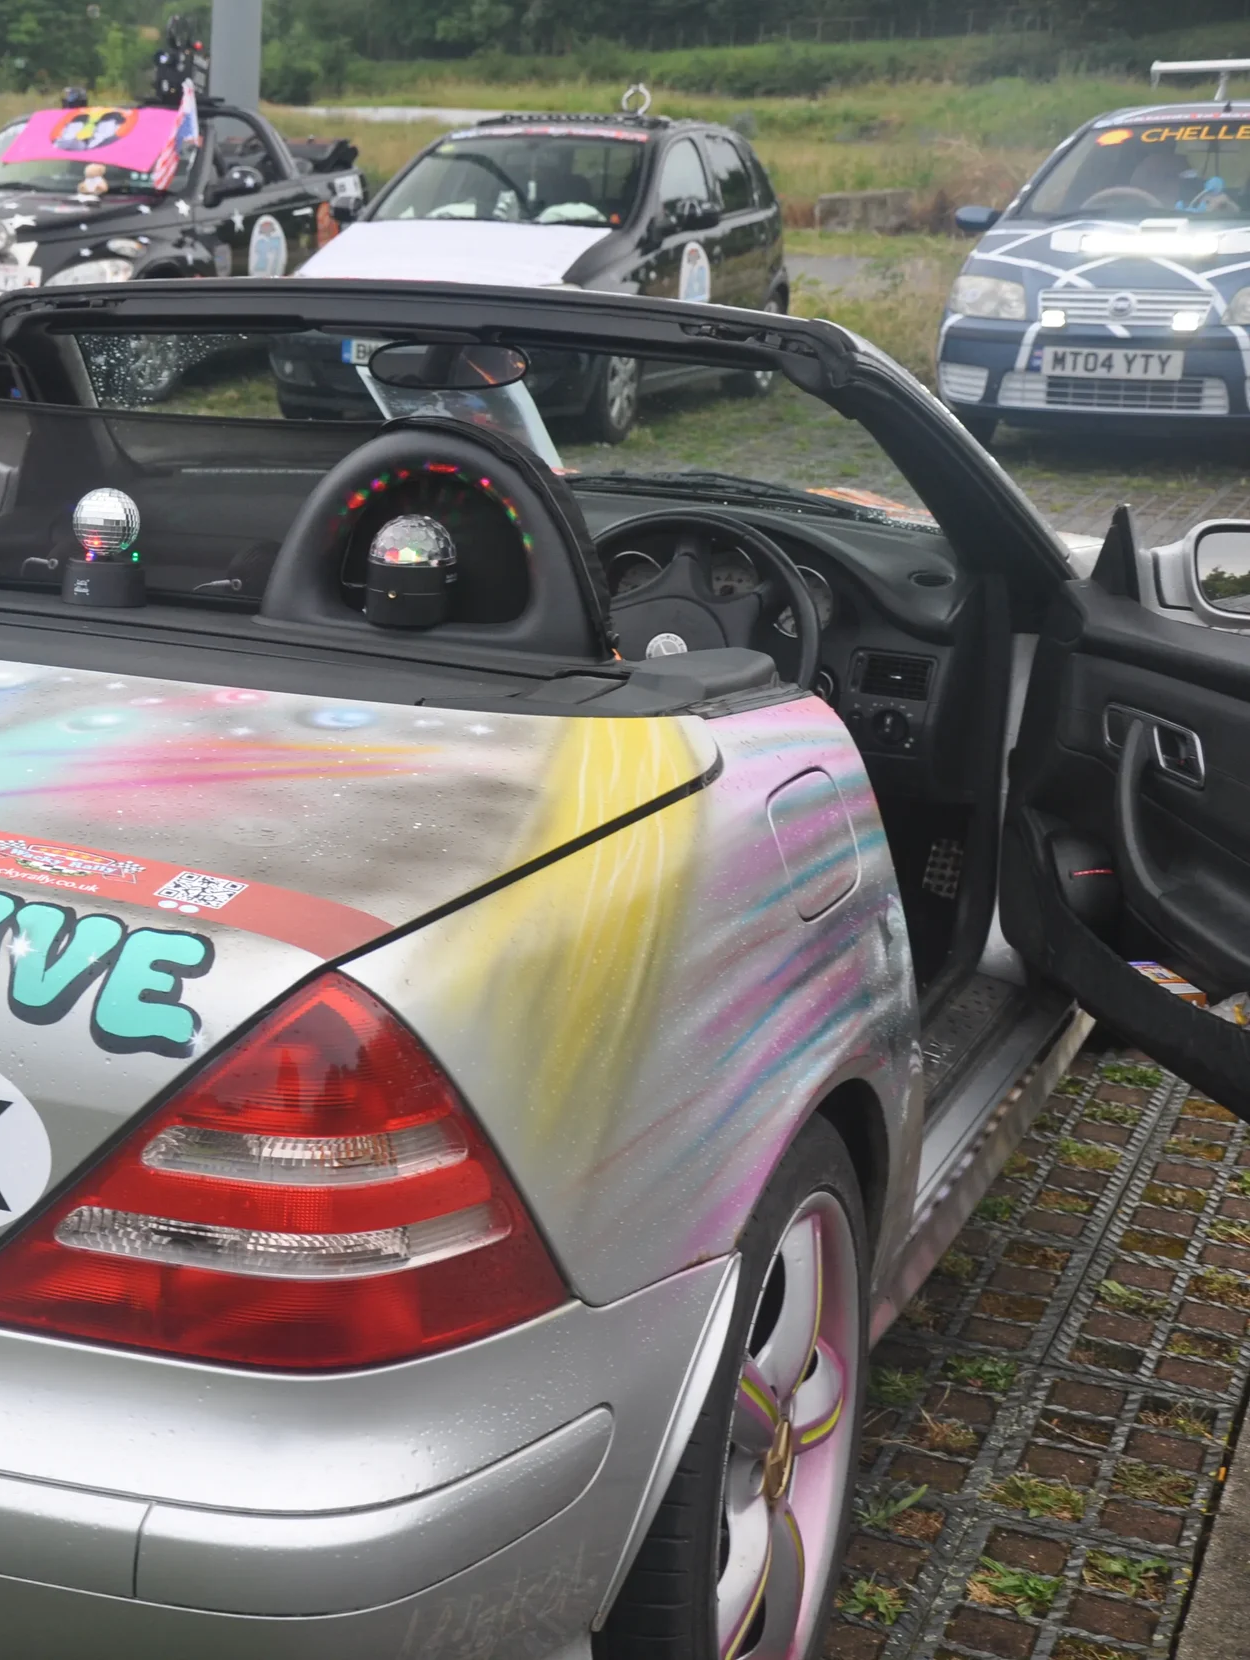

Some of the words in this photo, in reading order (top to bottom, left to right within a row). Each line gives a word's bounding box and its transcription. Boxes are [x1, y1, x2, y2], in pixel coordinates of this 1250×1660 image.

[1141, 125, 1250, 143] CHELLE
[1051, 350, 1114, 373] MT04
[1123, 353, 1172, 375] YTY
